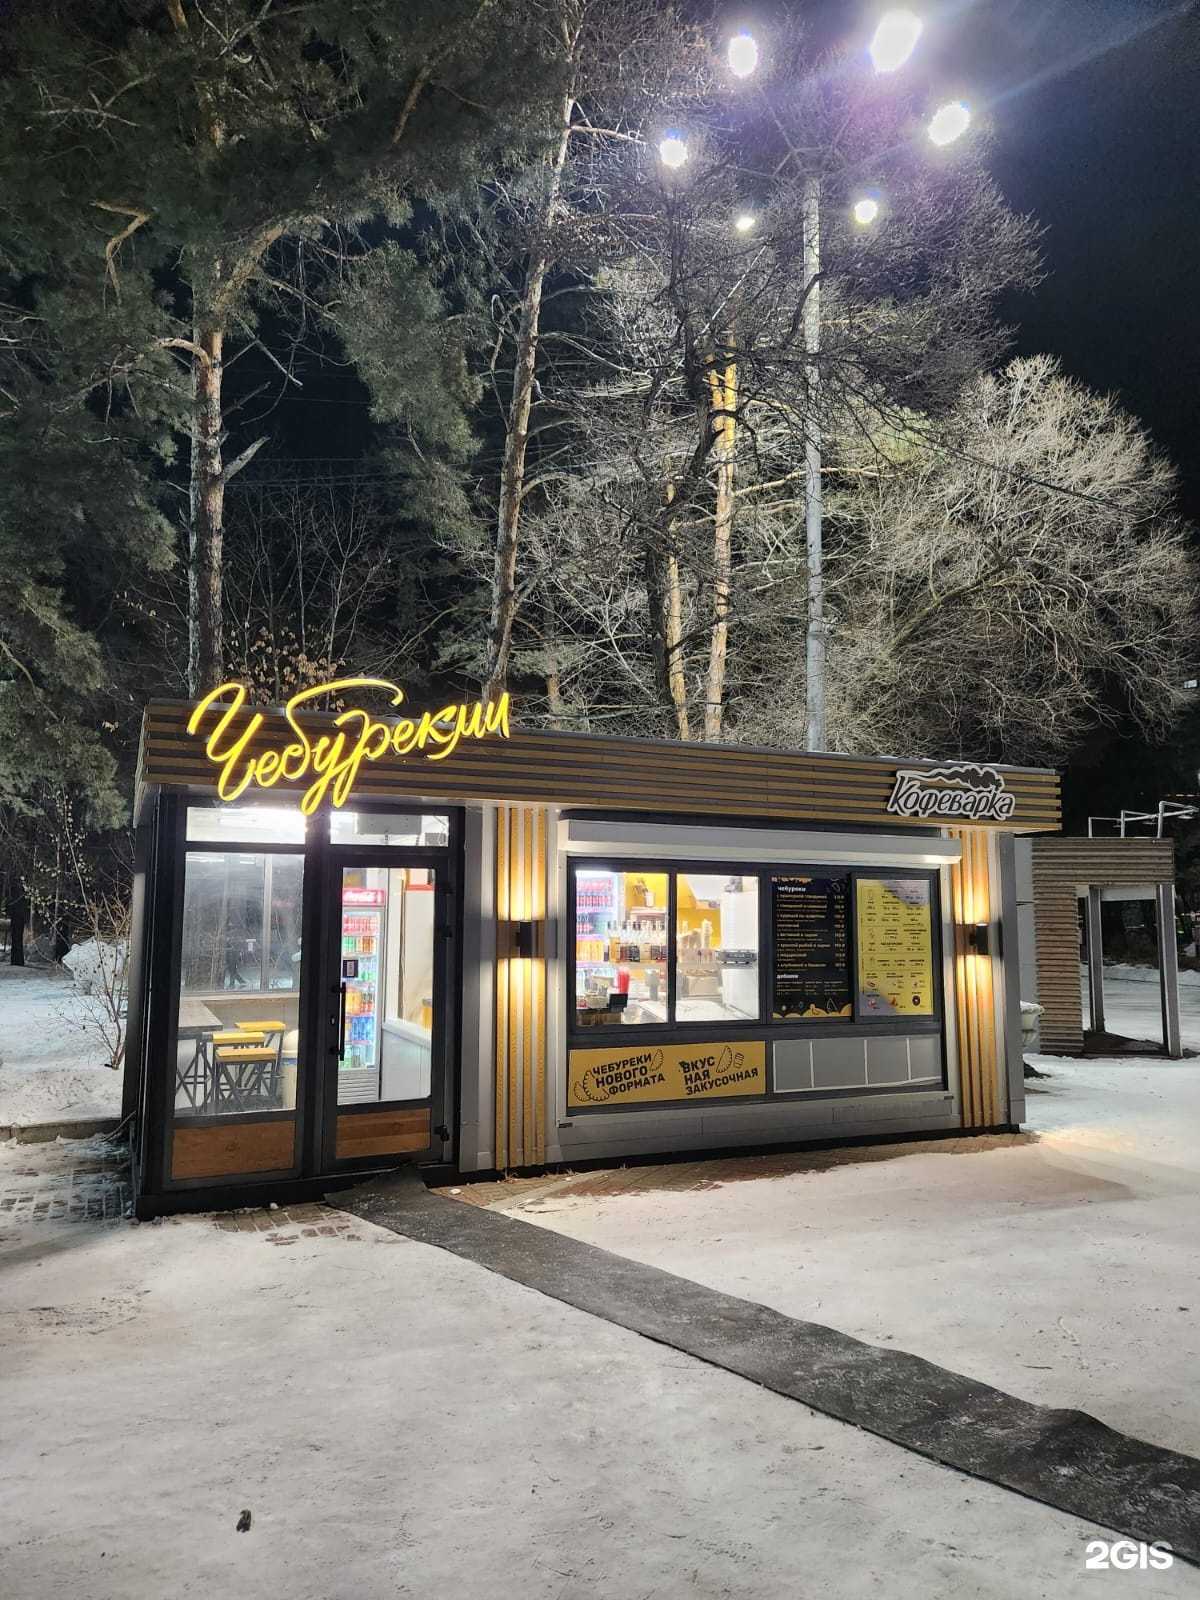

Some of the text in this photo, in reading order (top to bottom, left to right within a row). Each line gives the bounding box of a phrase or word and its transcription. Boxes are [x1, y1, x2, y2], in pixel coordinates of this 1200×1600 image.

[888, 773, 1015, 821] Кофеварка
[592, 1053, 652, 1076] ЧЕБУРЕКИ
[680, 1056, 716, 1074] ВКУС
[595, 1065, 648, 1089] НОВОГО
[608, 1073, 666, 1096] ФОРМАТА
[684, 1069, 711, 1086] НАЯ
[685, 1067, 759, 1096] ЗАКУСОЧНАЯ
